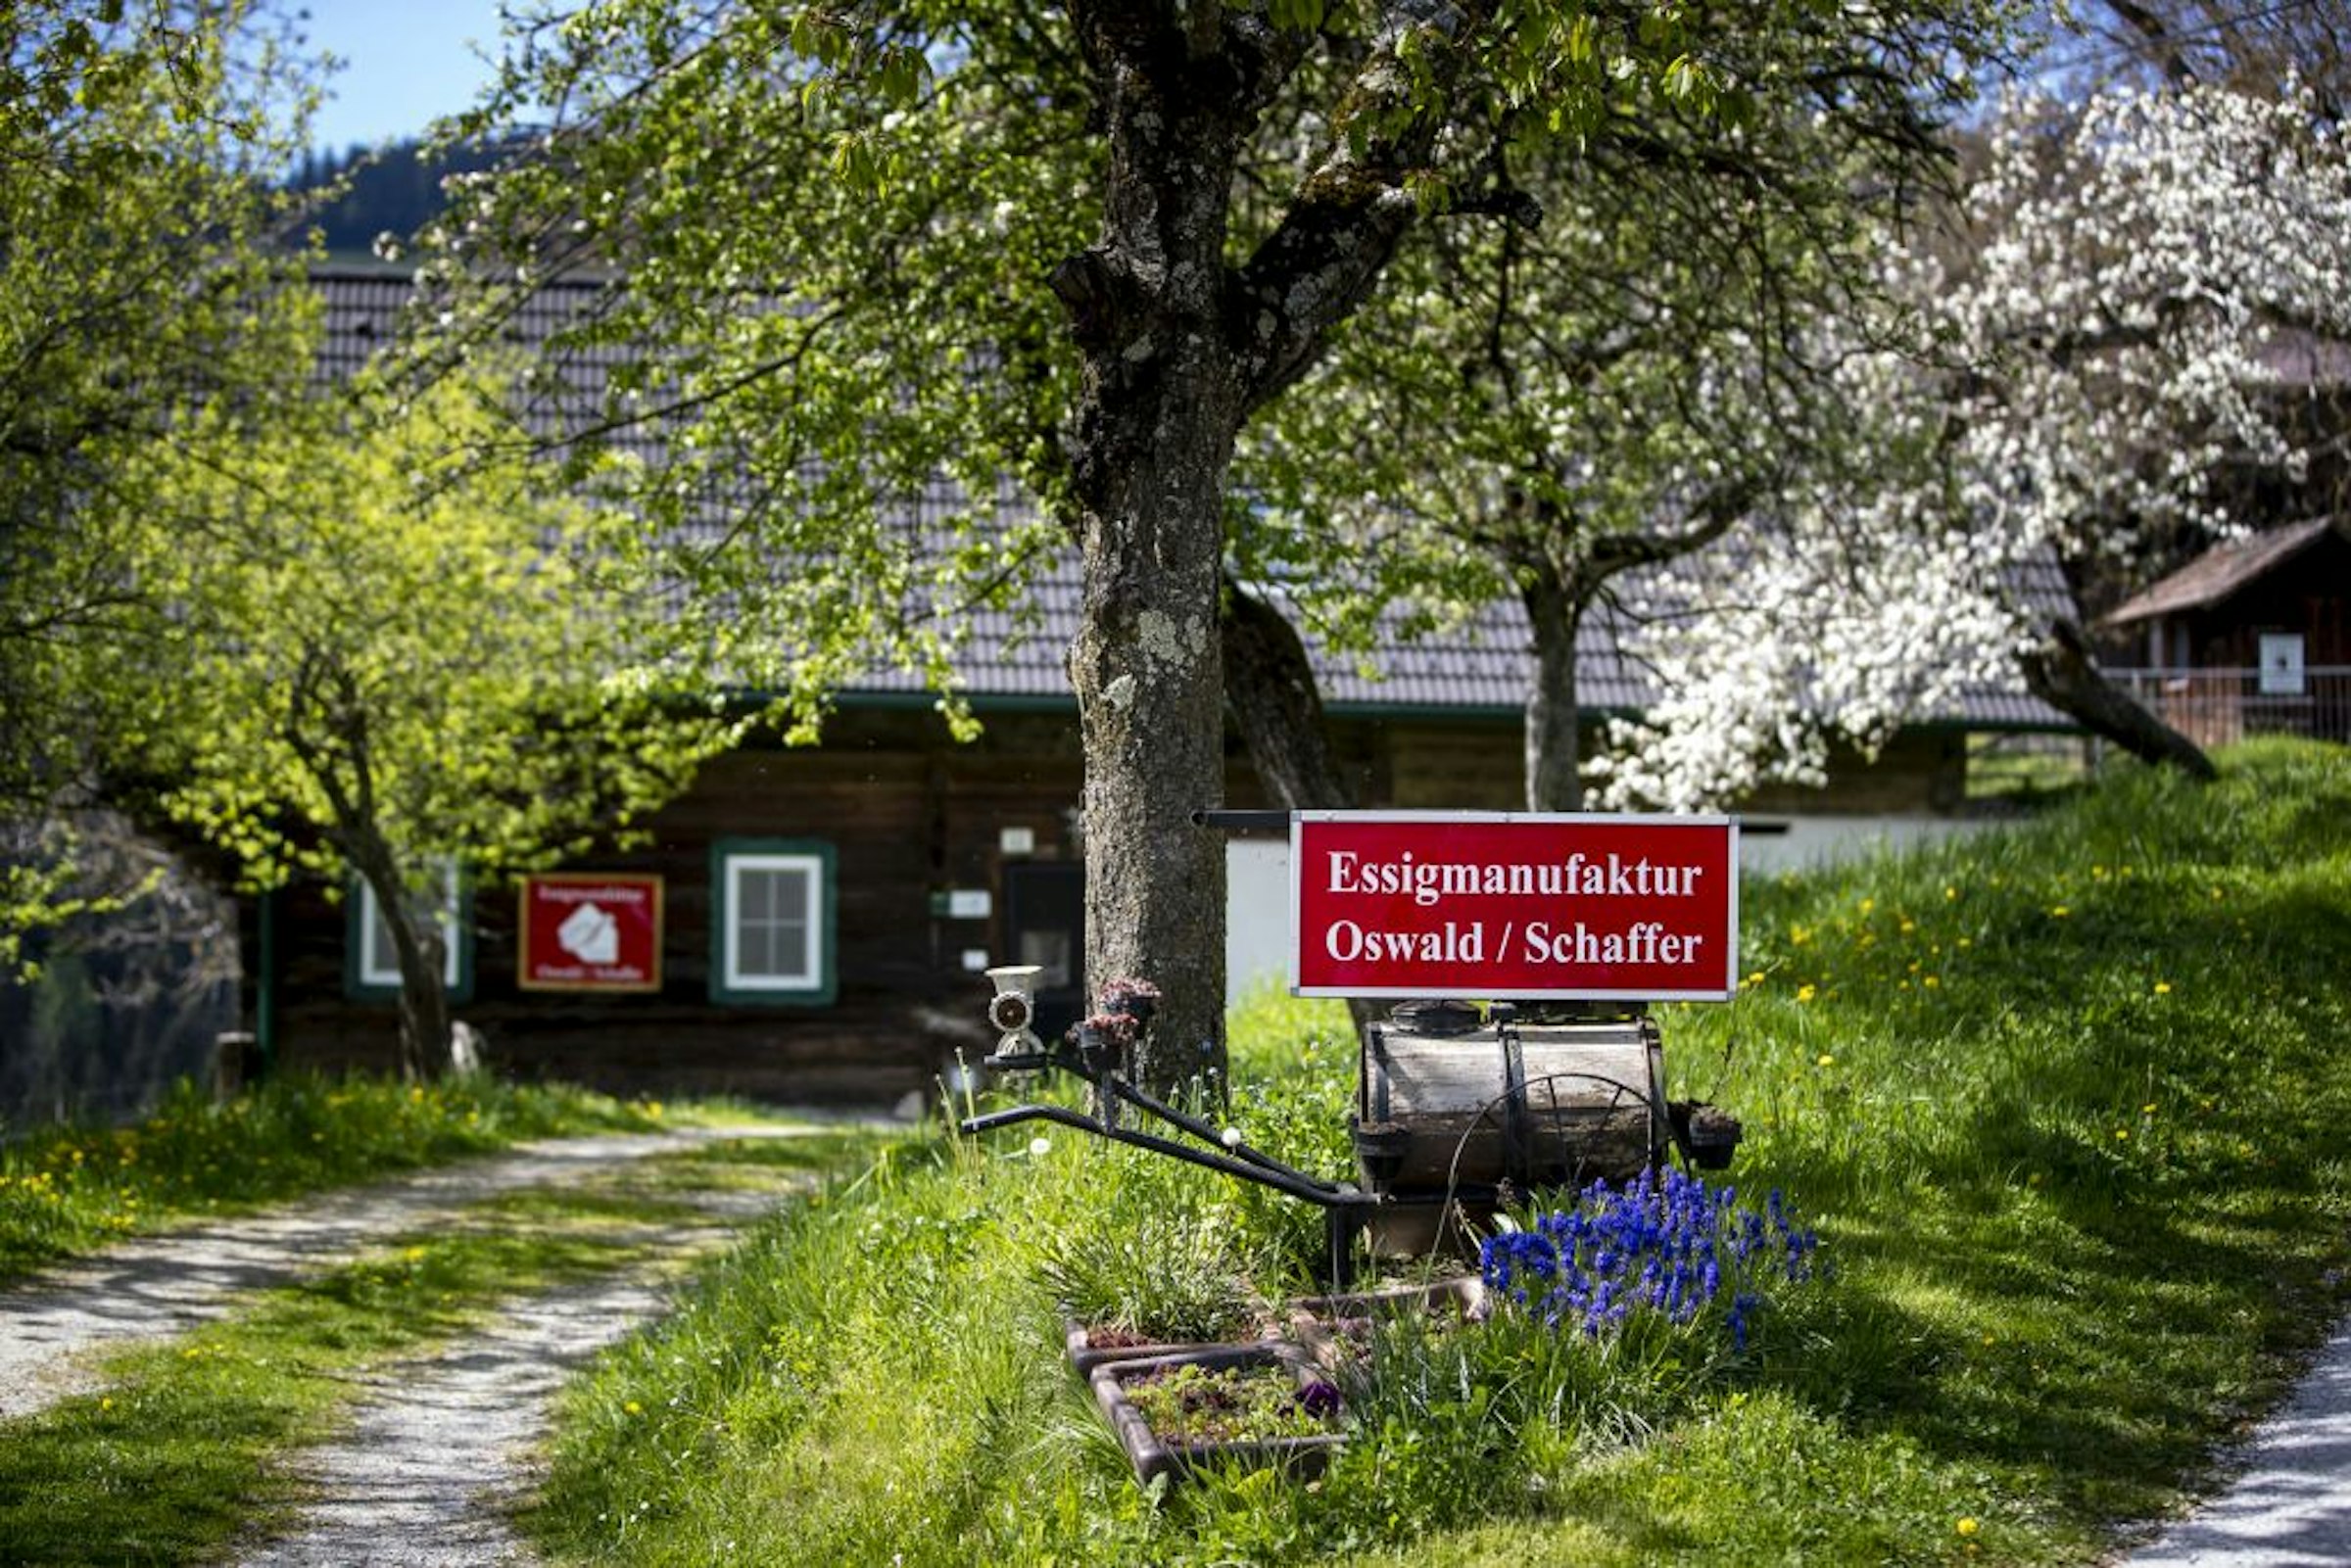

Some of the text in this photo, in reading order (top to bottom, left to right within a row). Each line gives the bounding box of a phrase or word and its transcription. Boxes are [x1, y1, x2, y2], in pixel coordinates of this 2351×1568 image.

[1327, 851, 1703, 906] Essigmanufaktur
[1325, 920, 1703, 964] Oswald / Schaffer
